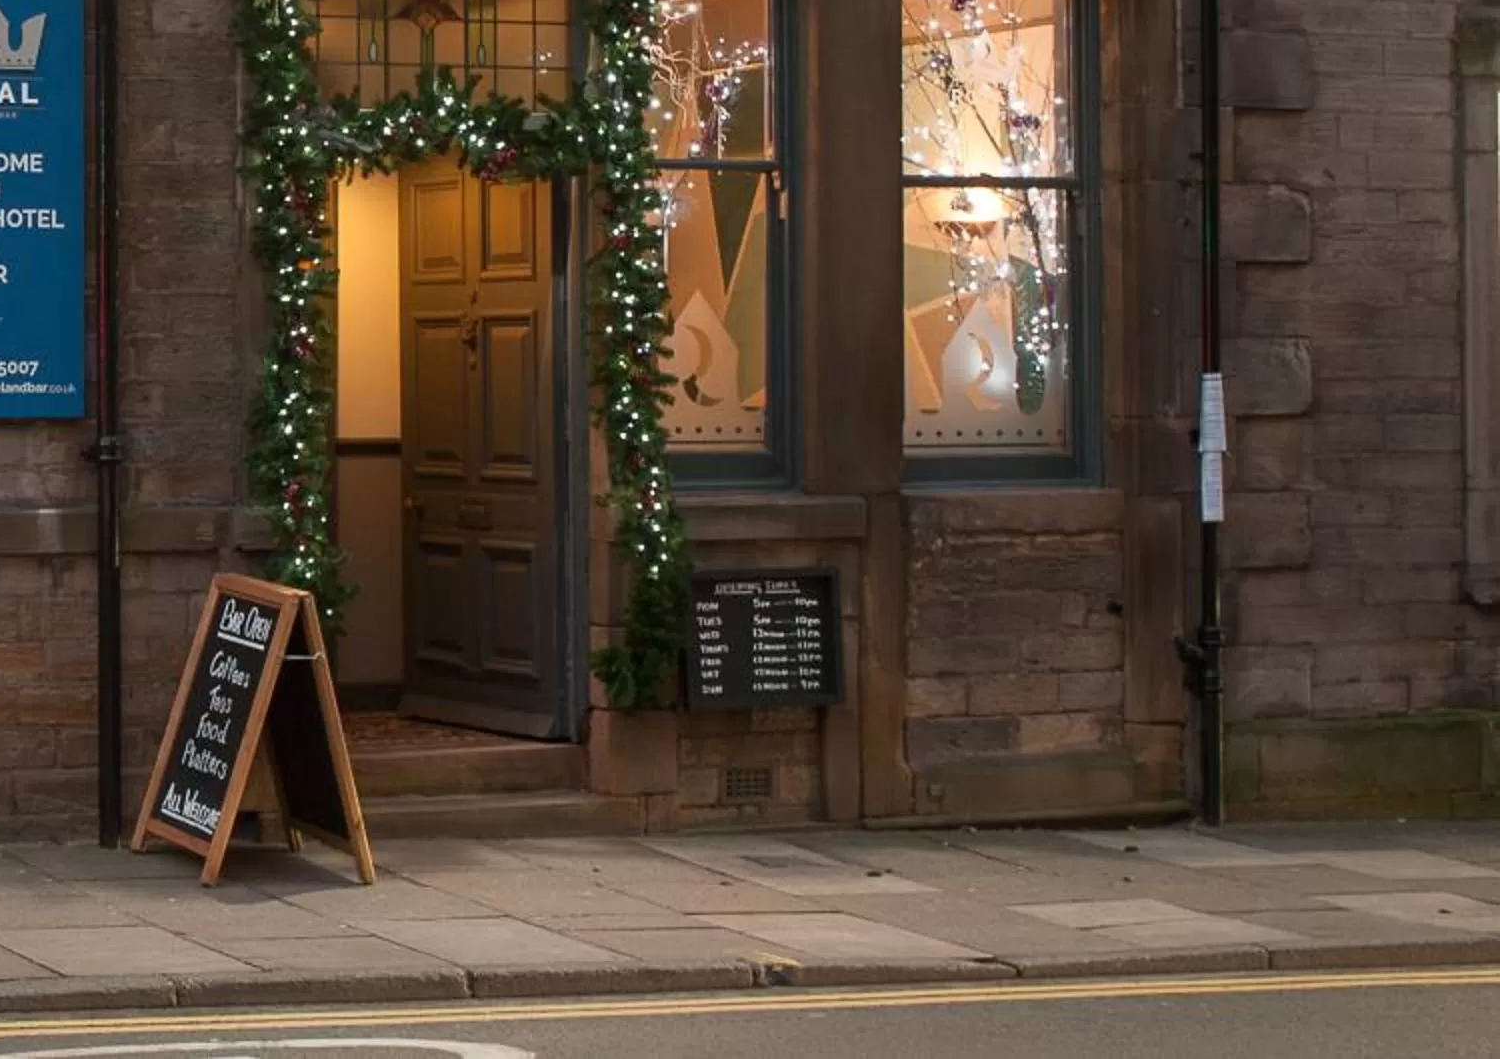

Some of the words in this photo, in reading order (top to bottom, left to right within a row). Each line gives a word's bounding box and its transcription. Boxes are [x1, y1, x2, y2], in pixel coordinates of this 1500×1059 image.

[696, 615, 723, 627] TUES
[209, 649, 252, 689] Coffees
[209, 684, 233, 714] Teas
[196, 711, 232, 745] Food
[181, 737, 229, 780] Platters
